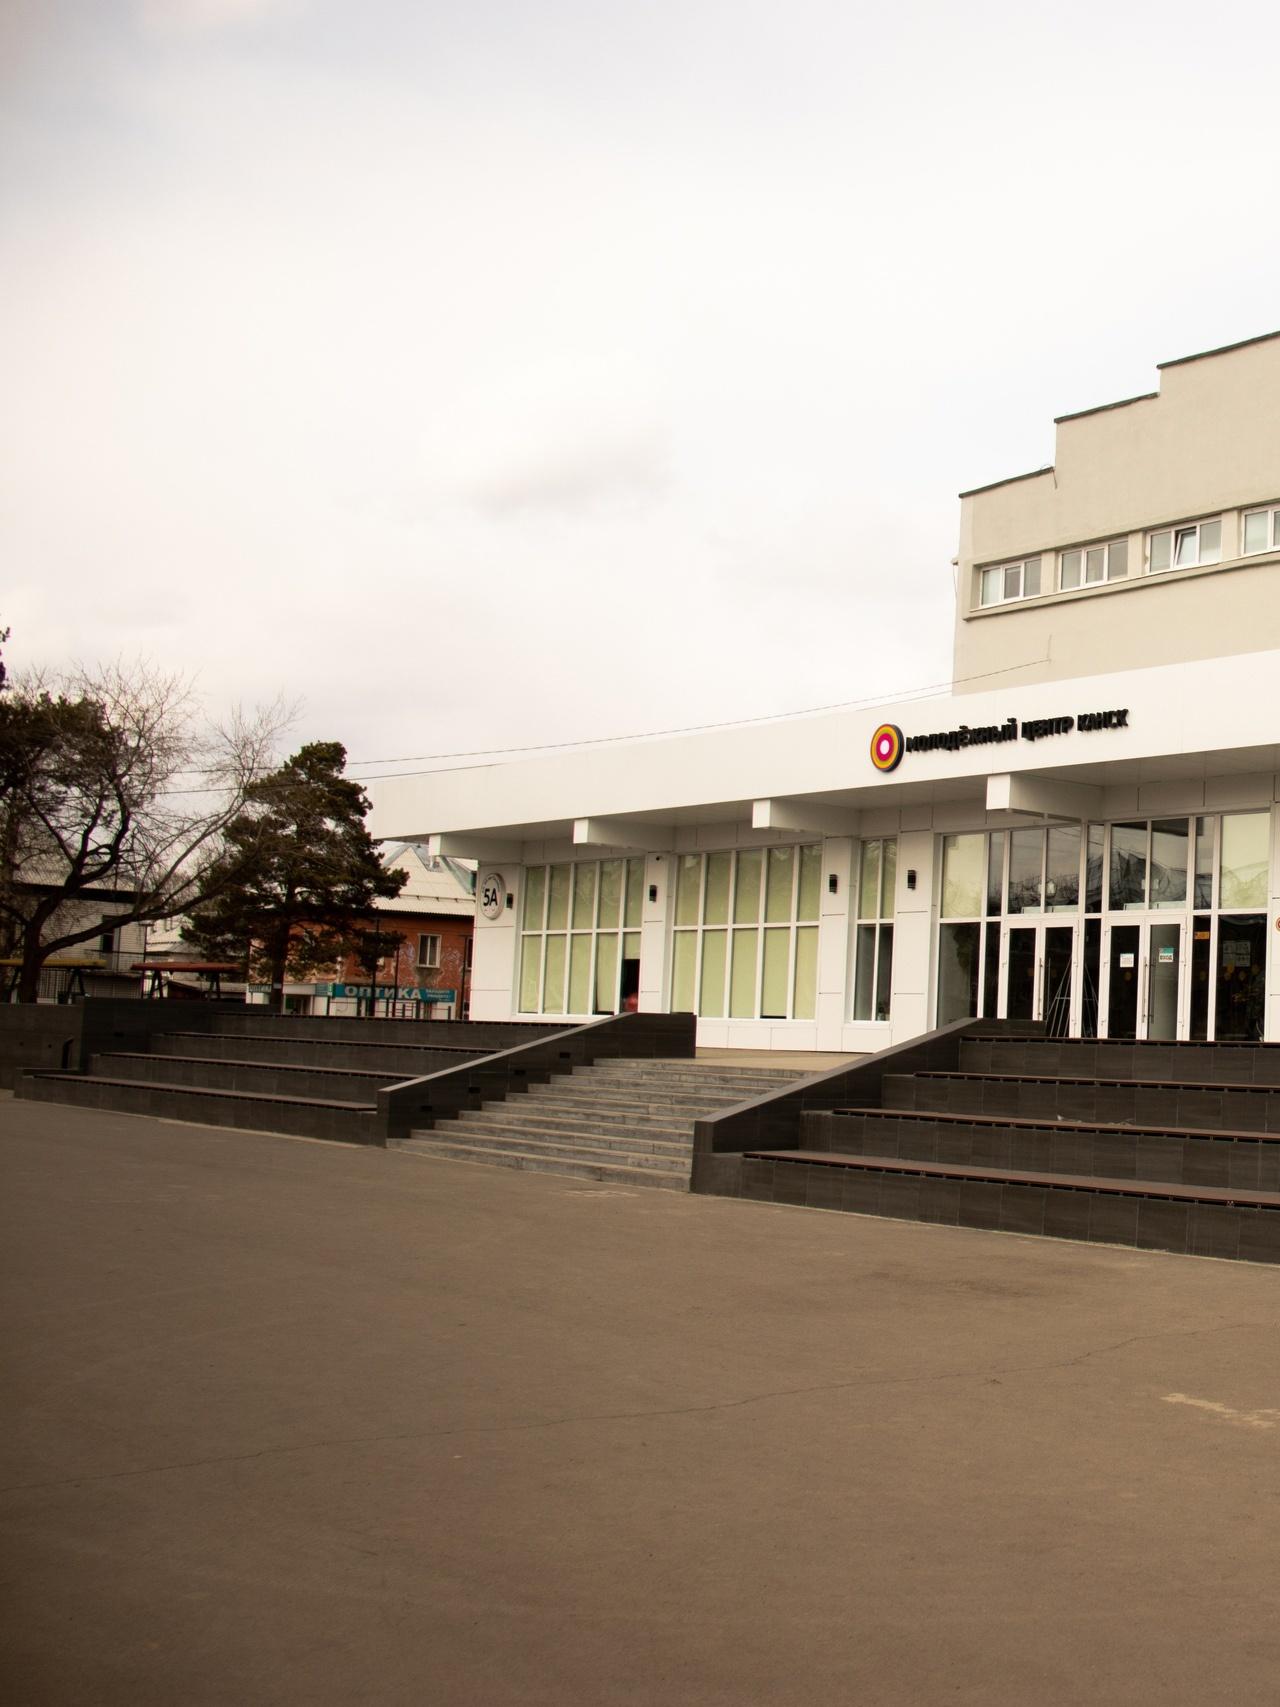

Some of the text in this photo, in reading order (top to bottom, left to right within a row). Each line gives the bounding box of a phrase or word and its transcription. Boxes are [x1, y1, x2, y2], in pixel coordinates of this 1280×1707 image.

[906, 709, 1128, 753] МОЛОДЁЖНЫЙ ЦЕНТР КАНСК
[483, 887, 498, 906] 5А
[344, 986, 422, 999] ОПТИКА
